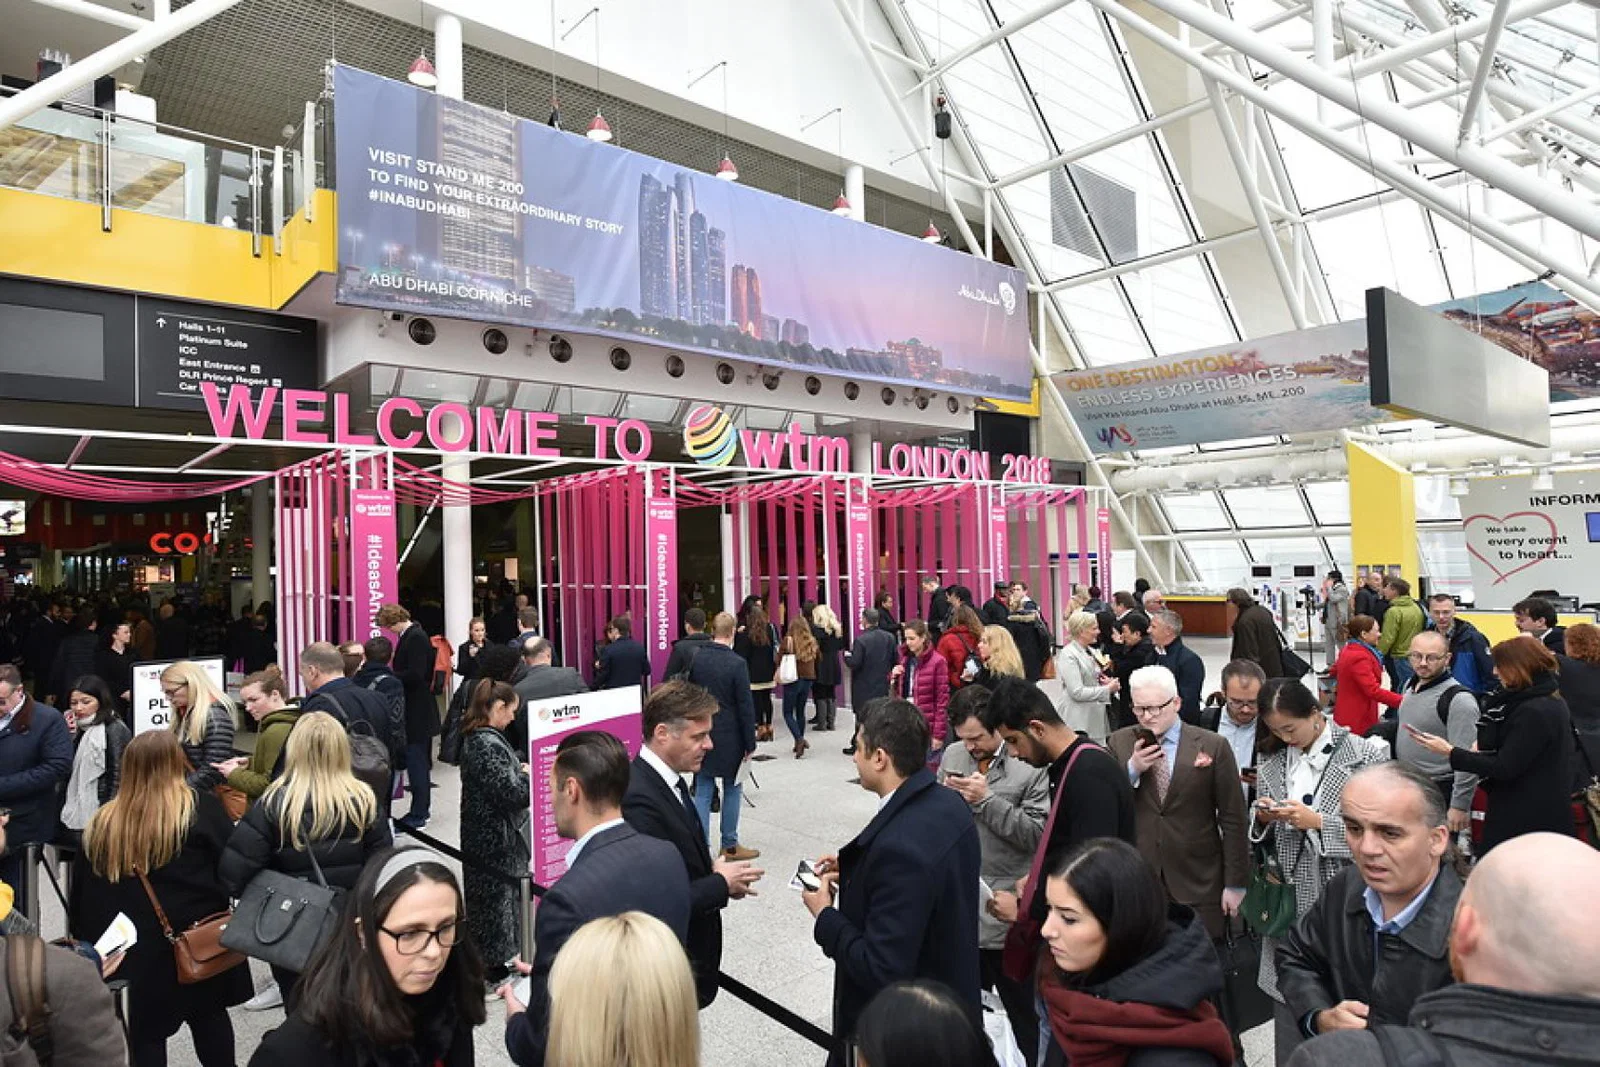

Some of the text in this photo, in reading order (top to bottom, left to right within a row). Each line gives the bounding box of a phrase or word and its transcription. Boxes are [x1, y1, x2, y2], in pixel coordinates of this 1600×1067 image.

[368, 147, 525, 196] VISIT STAND ME 200
[367, 168, 625, 235] TO FIND YOUR EXTRAORDINARY STORY
[368, 188, 471, 220] #INABUDHABI
[369, 273, 534, 308] ABU DHABI CORNICHE
[178, 321, 204, 332] Halls
[178, 333, 249, 350] Platinum Suite
[178, 345, 199, 356] ICC
[178, 357, 247, 373] East Entrance
[1066, 354, 1236, 392] ONE DESTINATION
[178, 369, 270, 387] DLR Prince Regent
[178, 380, 198, 392] Car
[1077, 387, 1154, 408] ENDLESS
[1169, 401, 1199, 413] Dhabi
[199, 381, 561, 457] WELCOME
[585, 415, 653, 463] TO
[739, 422, 850, 473] wtm
[872, 441, 991, 481] LONDON
[1529, 493, 1600, 506] INFORM
[1485, 525, 1526, 534] We take
[1487, 535, 1568, 547] every event
[1499, 548, 1573, 560] to heart...
[656, 533, 670, 651] #IdeasArriveHere
[552, 704, 581, 717] wtm
